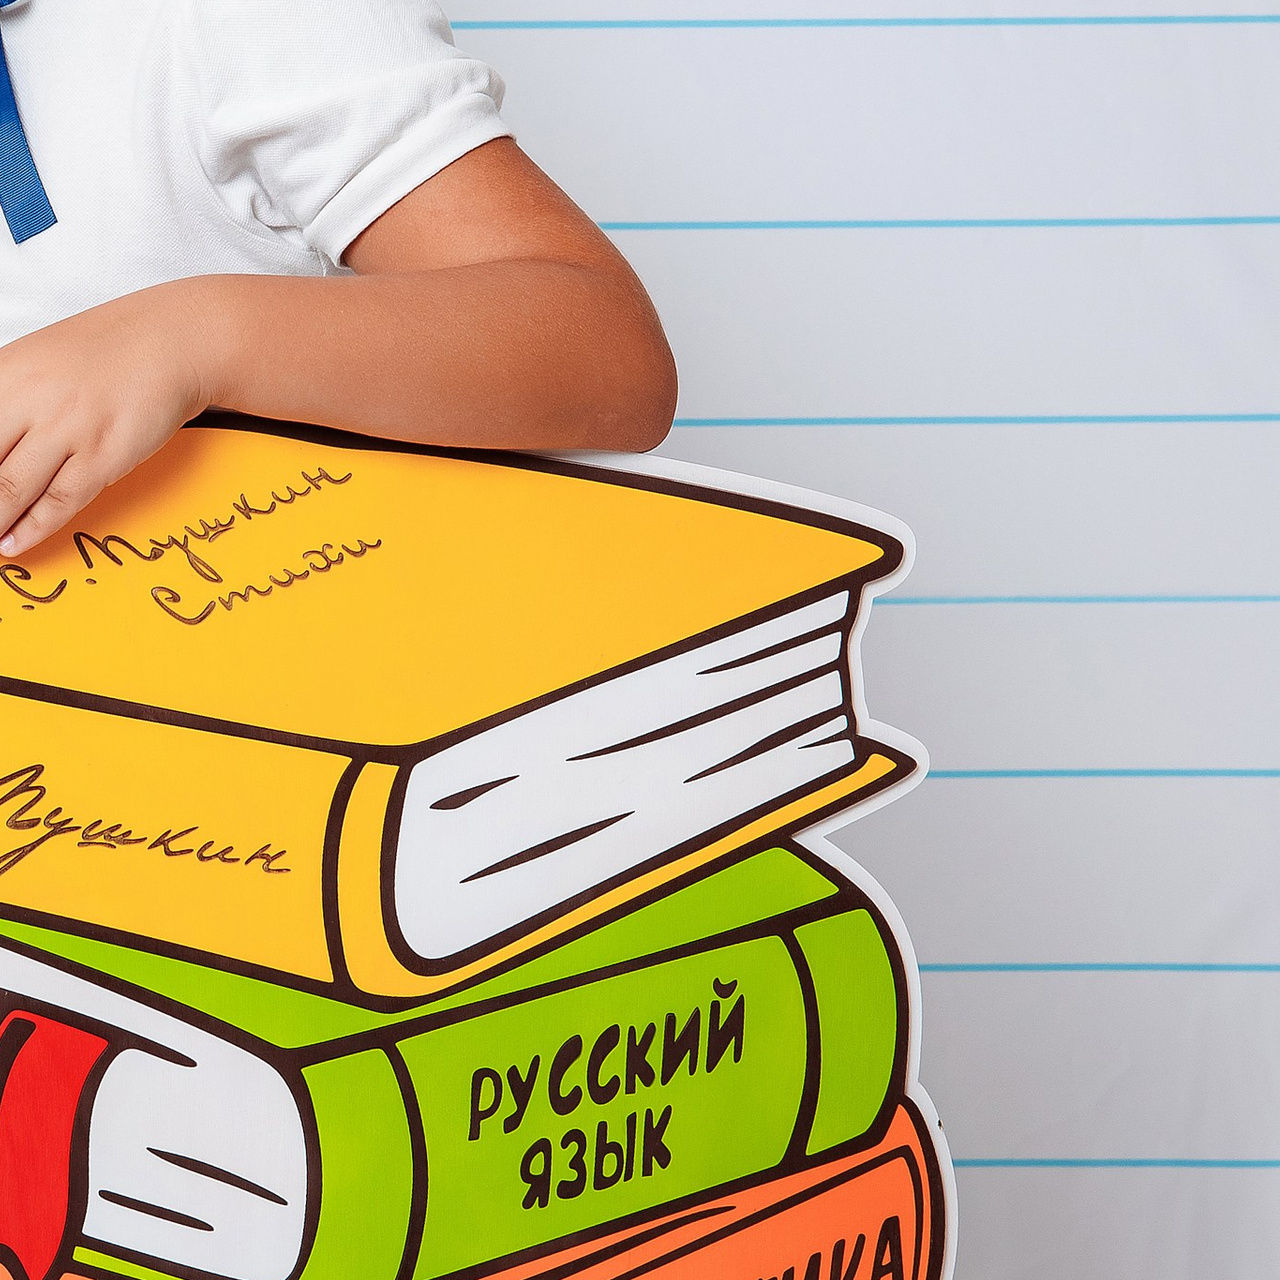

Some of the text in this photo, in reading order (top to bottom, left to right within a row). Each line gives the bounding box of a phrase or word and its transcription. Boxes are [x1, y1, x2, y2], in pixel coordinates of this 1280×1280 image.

[72, 466, 353, 584] Пушкин
[150, 538, 383, 626] Стихи
[467, 976, 746, 1142] РУССКИЙ
[519, 1104, 674, 1211] ЯЗЫК
